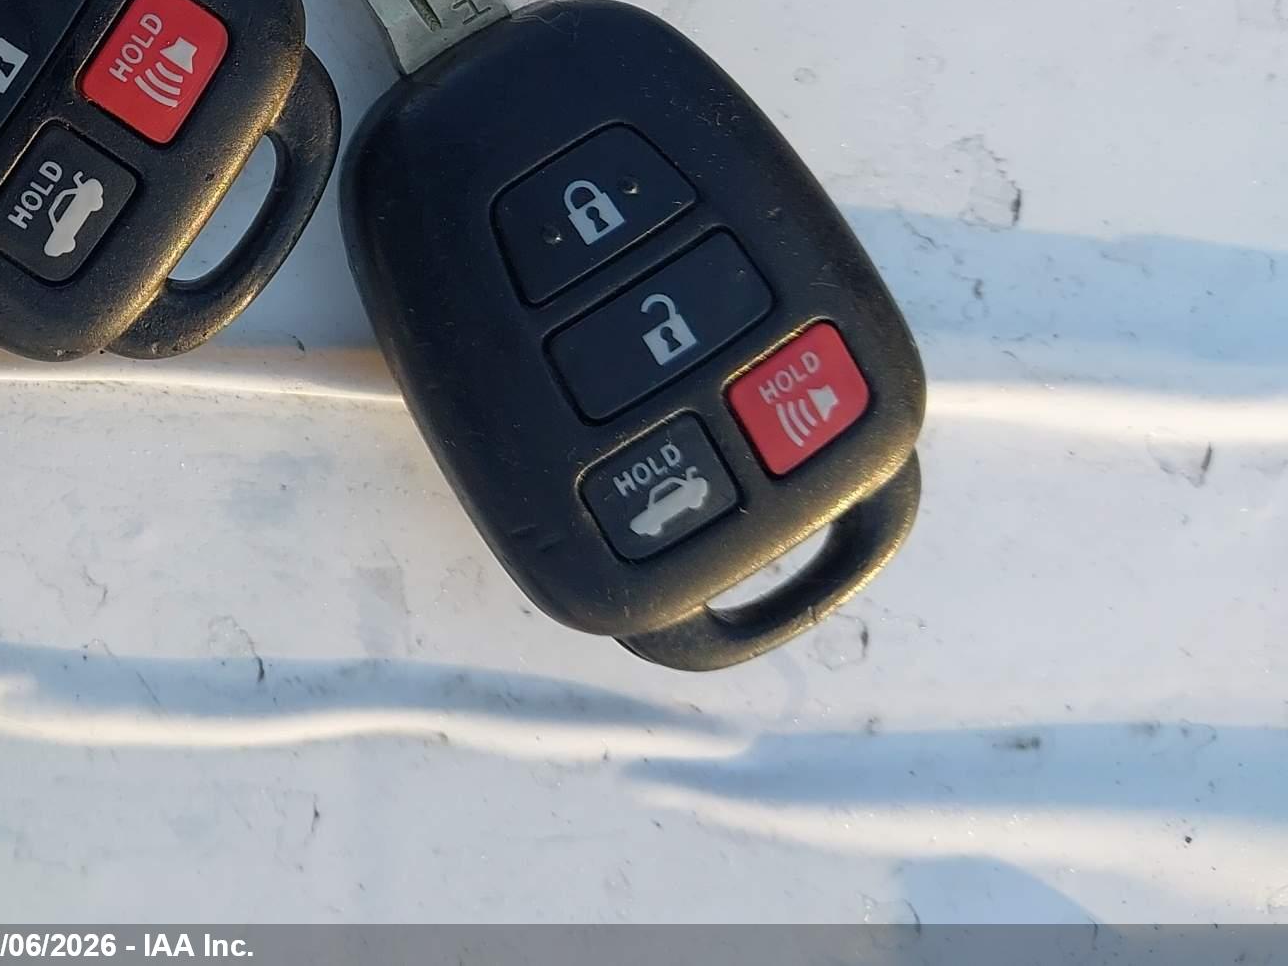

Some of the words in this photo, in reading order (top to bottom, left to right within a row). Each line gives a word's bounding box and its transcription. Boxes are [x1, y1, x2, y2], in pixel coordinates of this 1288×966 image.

[109, 13, 162, 83] HOLD
[7, 160, 63, 230] HOLD
[758, 351, 821, 405] HOLD
[612, 443, 681, 497] HOLD
